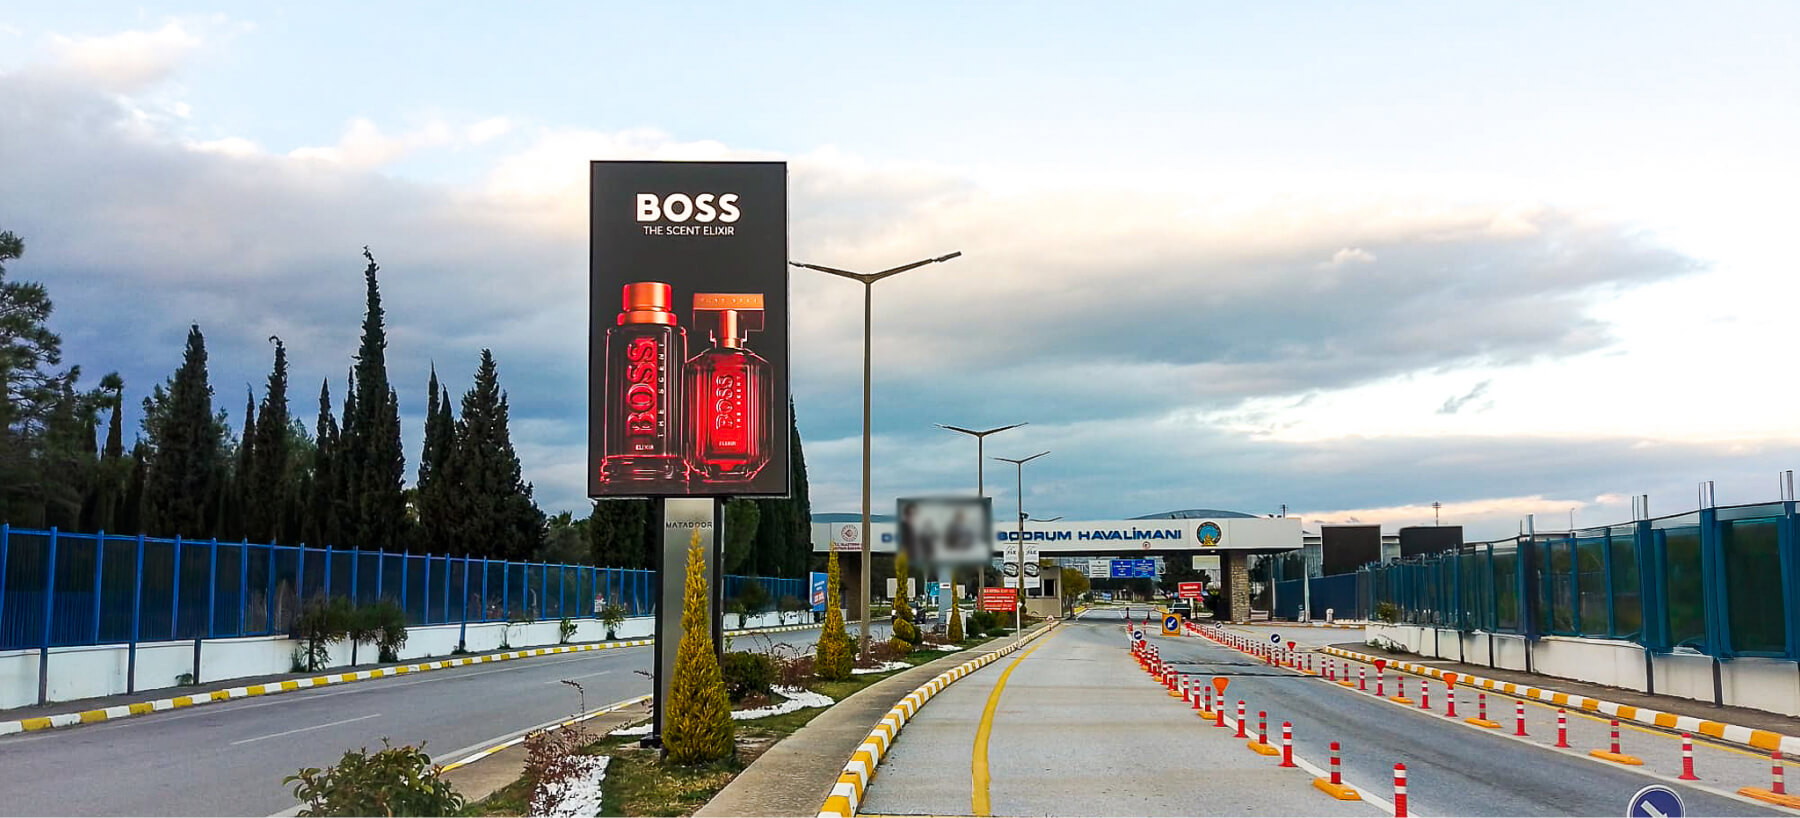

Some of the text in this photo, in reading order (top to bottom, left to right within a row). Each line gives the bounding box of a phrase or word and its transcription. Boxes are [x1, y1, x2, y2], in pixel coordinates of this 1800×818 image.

[636, 193, 741, 223] BOSS
[643, 226, 735, 236] THE SCENT ELIXIR
[626, 338, 656, 438] BOSS
[657, 343, 665, 438] THE SCENT
[715, 375, 734, 430] BOSS
[996, 526, 1182, 542] BODRUM HAVALİMANI
